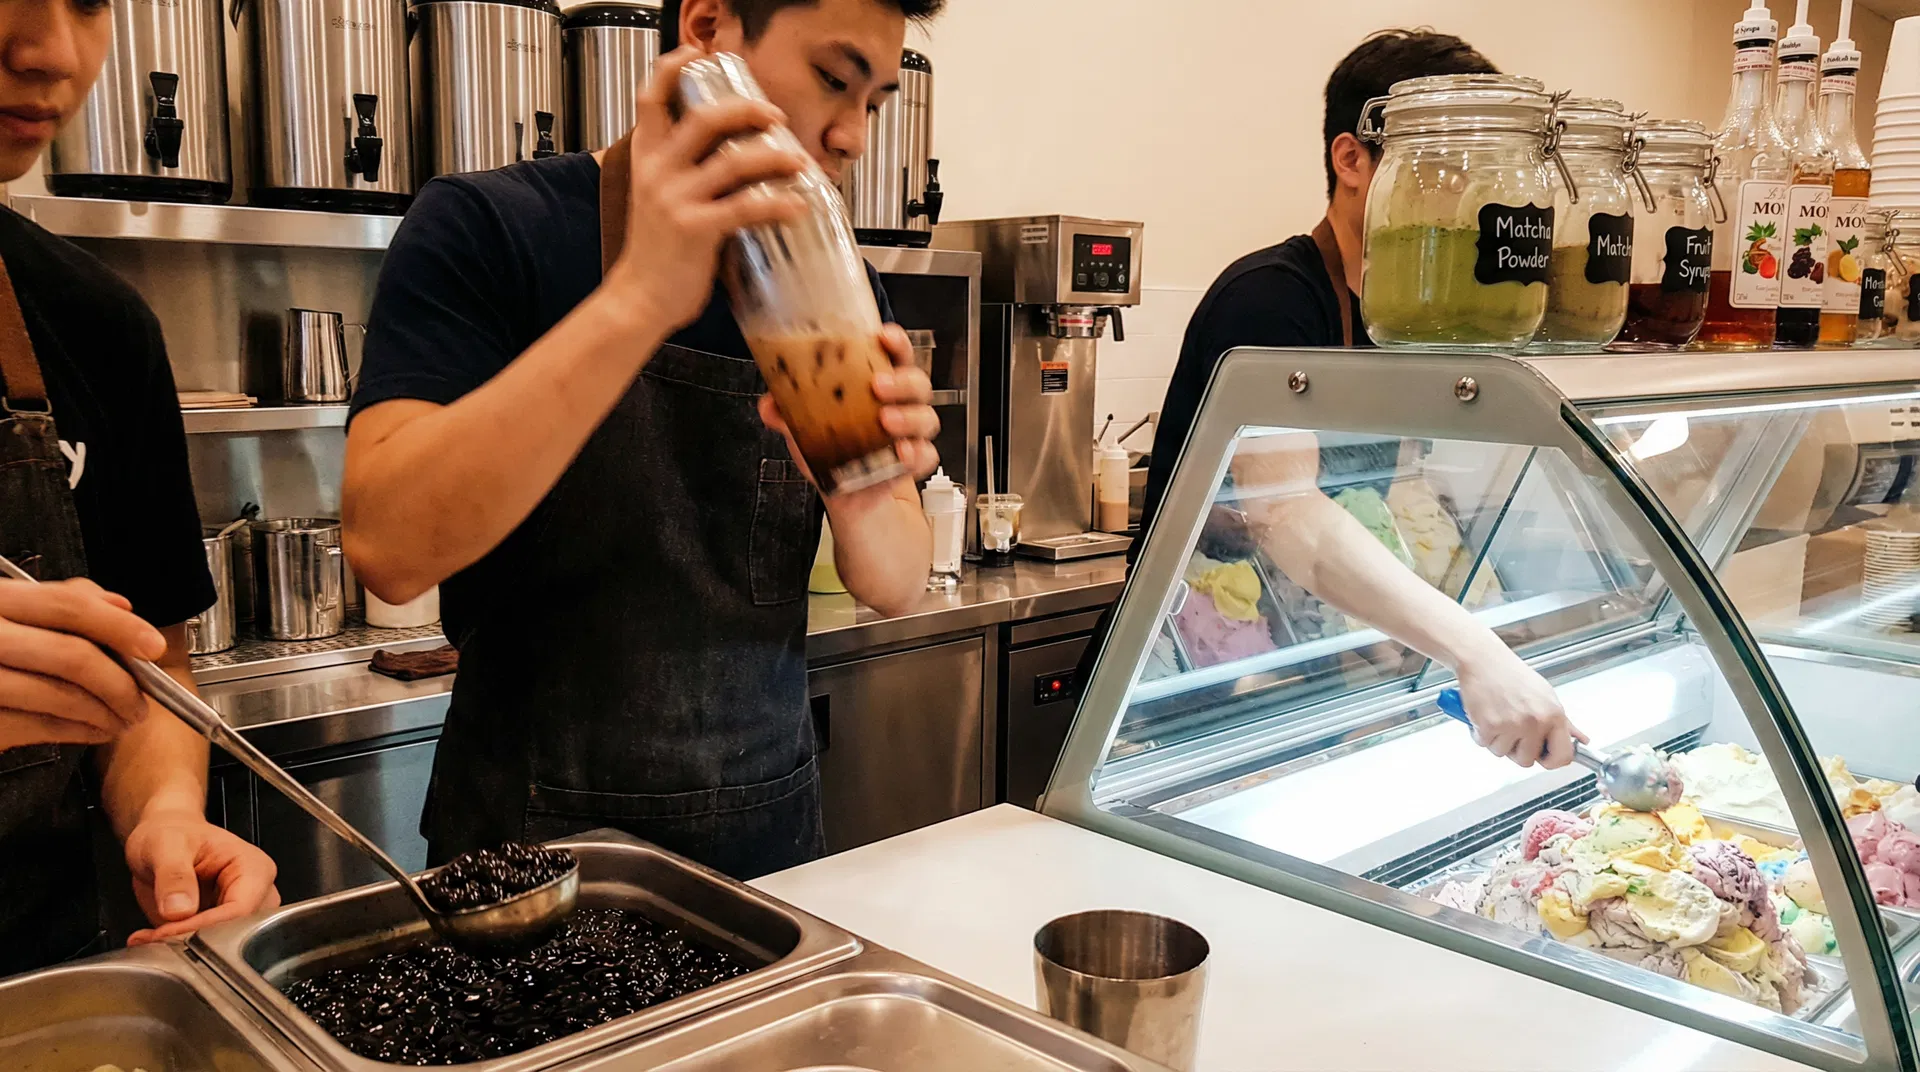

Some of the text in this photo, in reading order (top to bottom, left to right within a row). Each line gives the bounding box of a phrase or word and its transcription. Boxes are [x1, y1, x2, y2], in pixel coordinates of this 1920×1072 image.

[1496, 215, 1552, 240] Matcha
[1497, 245, 1549, 269] Powder
[1686, 235, 1711, 256] Fruit
